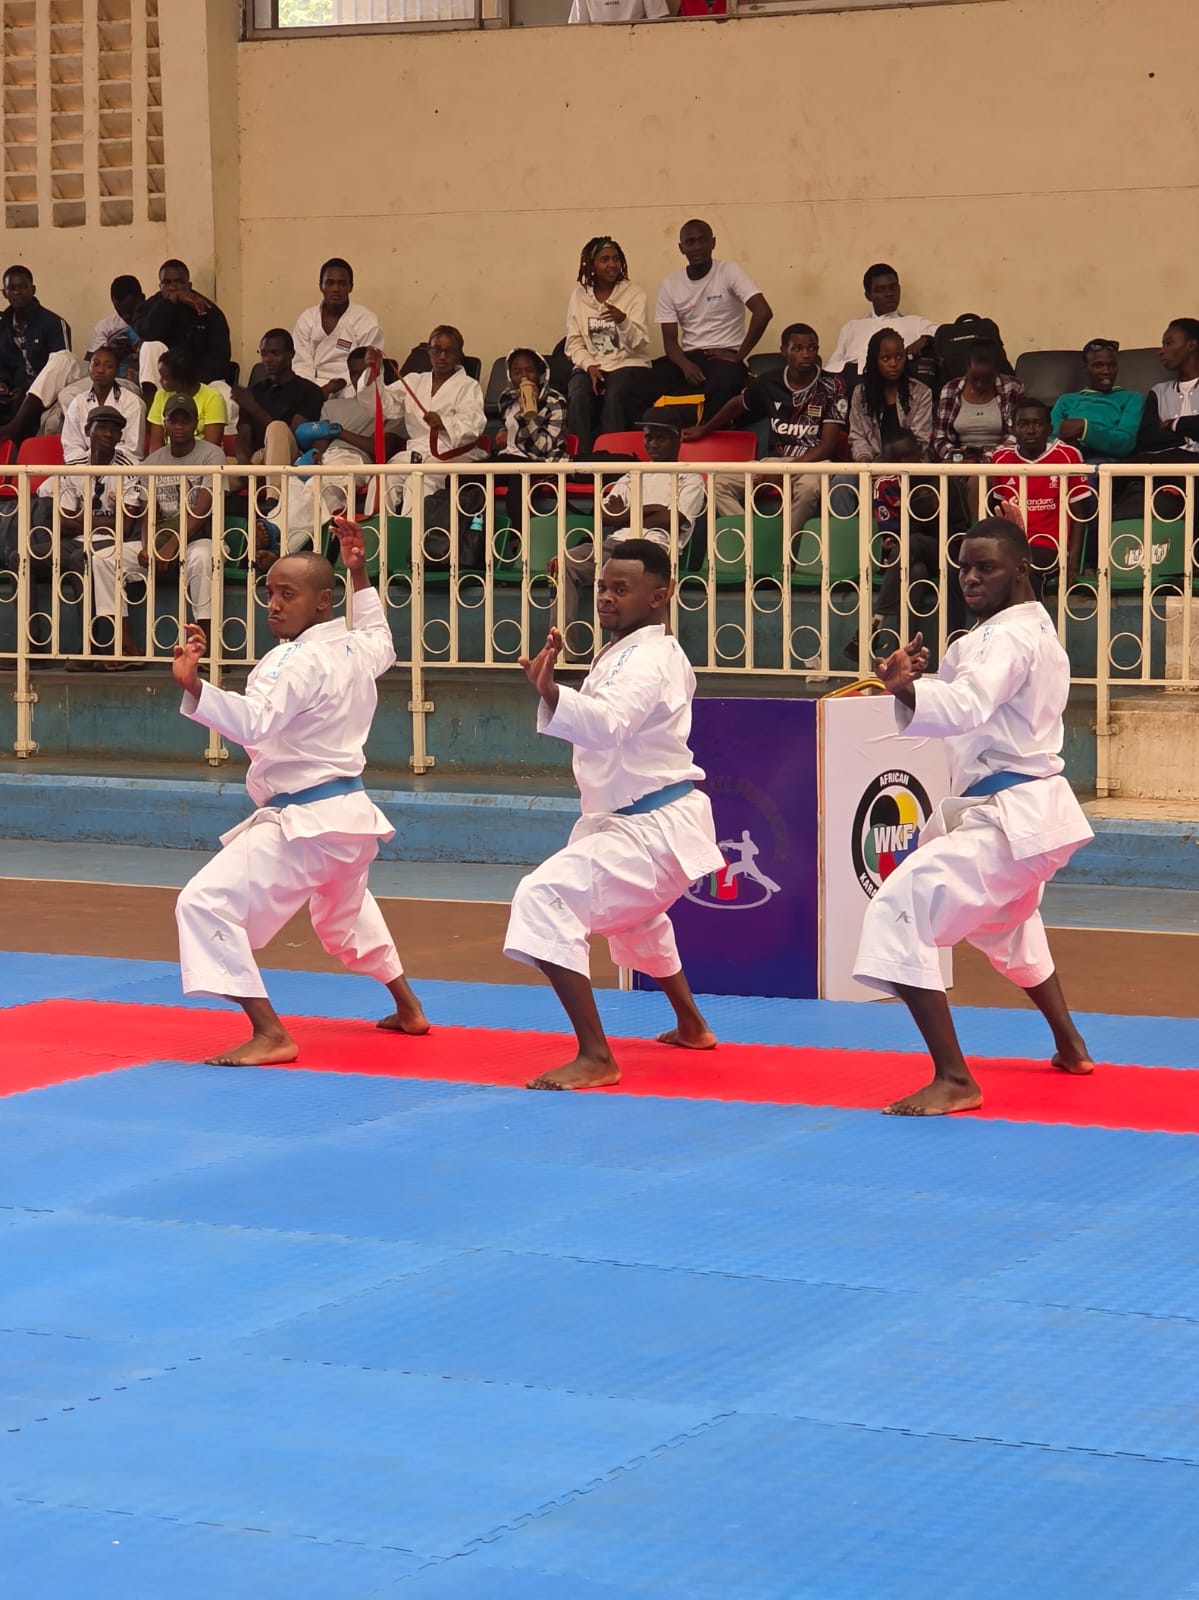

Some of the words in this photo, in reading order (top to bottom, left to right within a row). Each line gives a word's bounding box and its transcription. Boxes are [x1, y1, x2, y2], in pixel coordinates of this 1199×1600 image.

[771, 417, 819, 439] Kenya
[879, 772, 910, 787] AFRICAN
[873, 823, 914, 854] WKF
[859, 872, 877, 897] KARA
